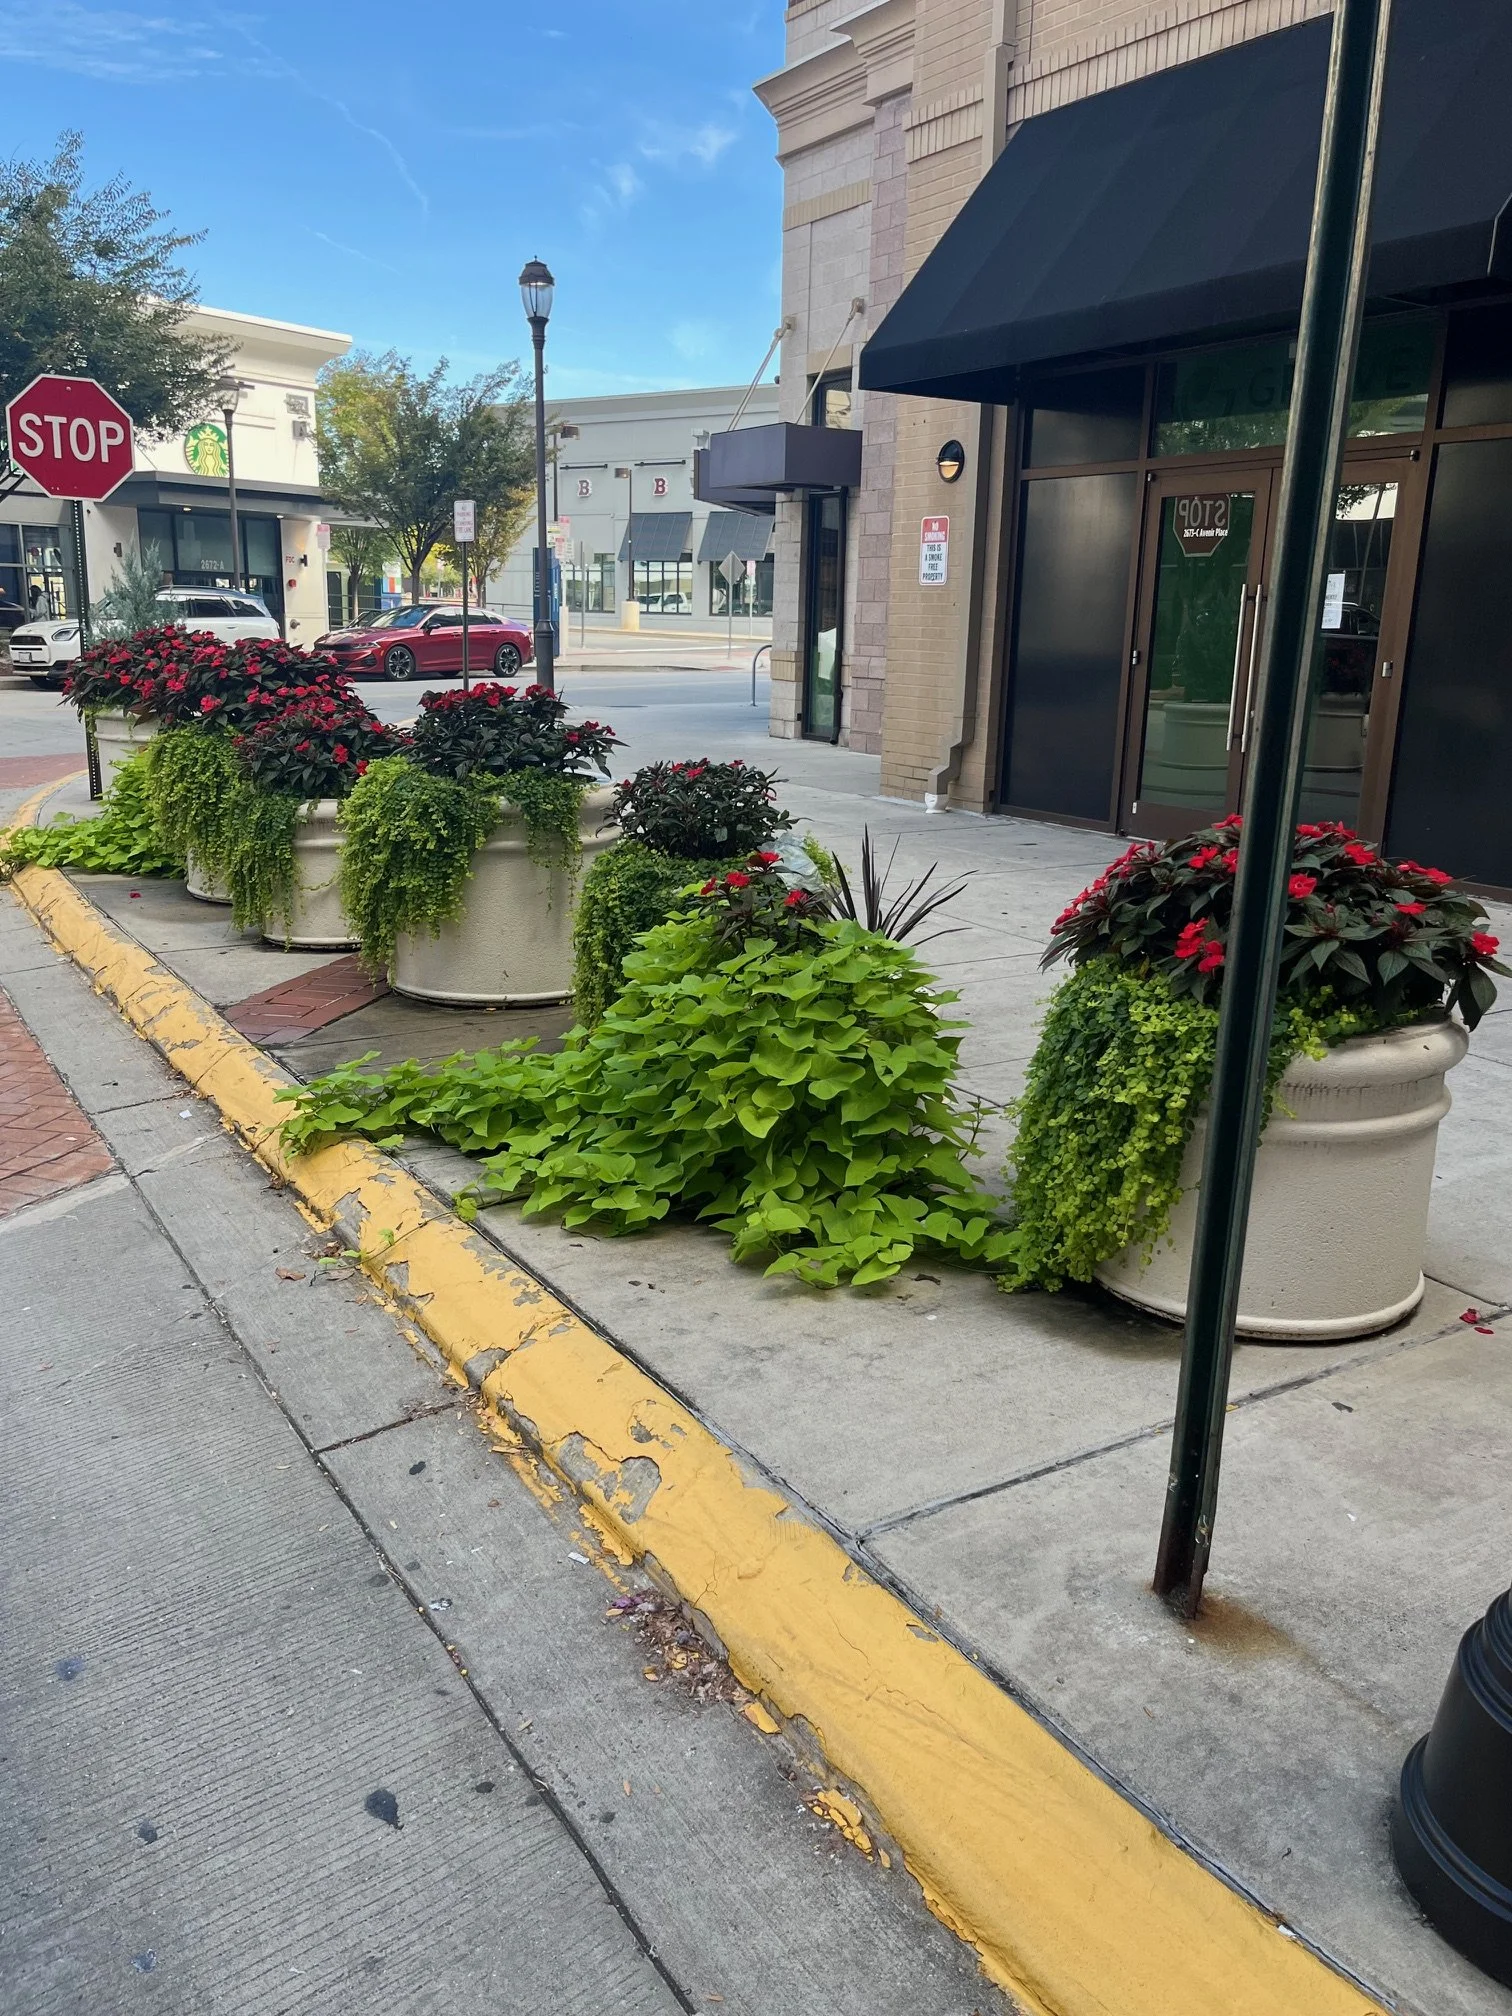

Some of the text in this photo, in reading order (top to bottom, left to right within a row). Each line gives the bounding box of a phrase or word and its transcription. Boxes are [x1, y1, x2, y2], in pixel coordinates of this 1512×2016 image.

[18, 412, 125, 463] STOP
[578, 479, 592, 497] B
[653, 477, 668, 496] B
[924, 531, 946, 542] SMOKING
[1215, 528, 1229, 537] Place
[926, 544, 936, 552] THIS
[928, 553, 943, 562] SMOKE
[200, 559, 225, 570] 2672-A
[928, 563, 938, 571] FREE
[922, 572, 944, 581] PROPERTY
